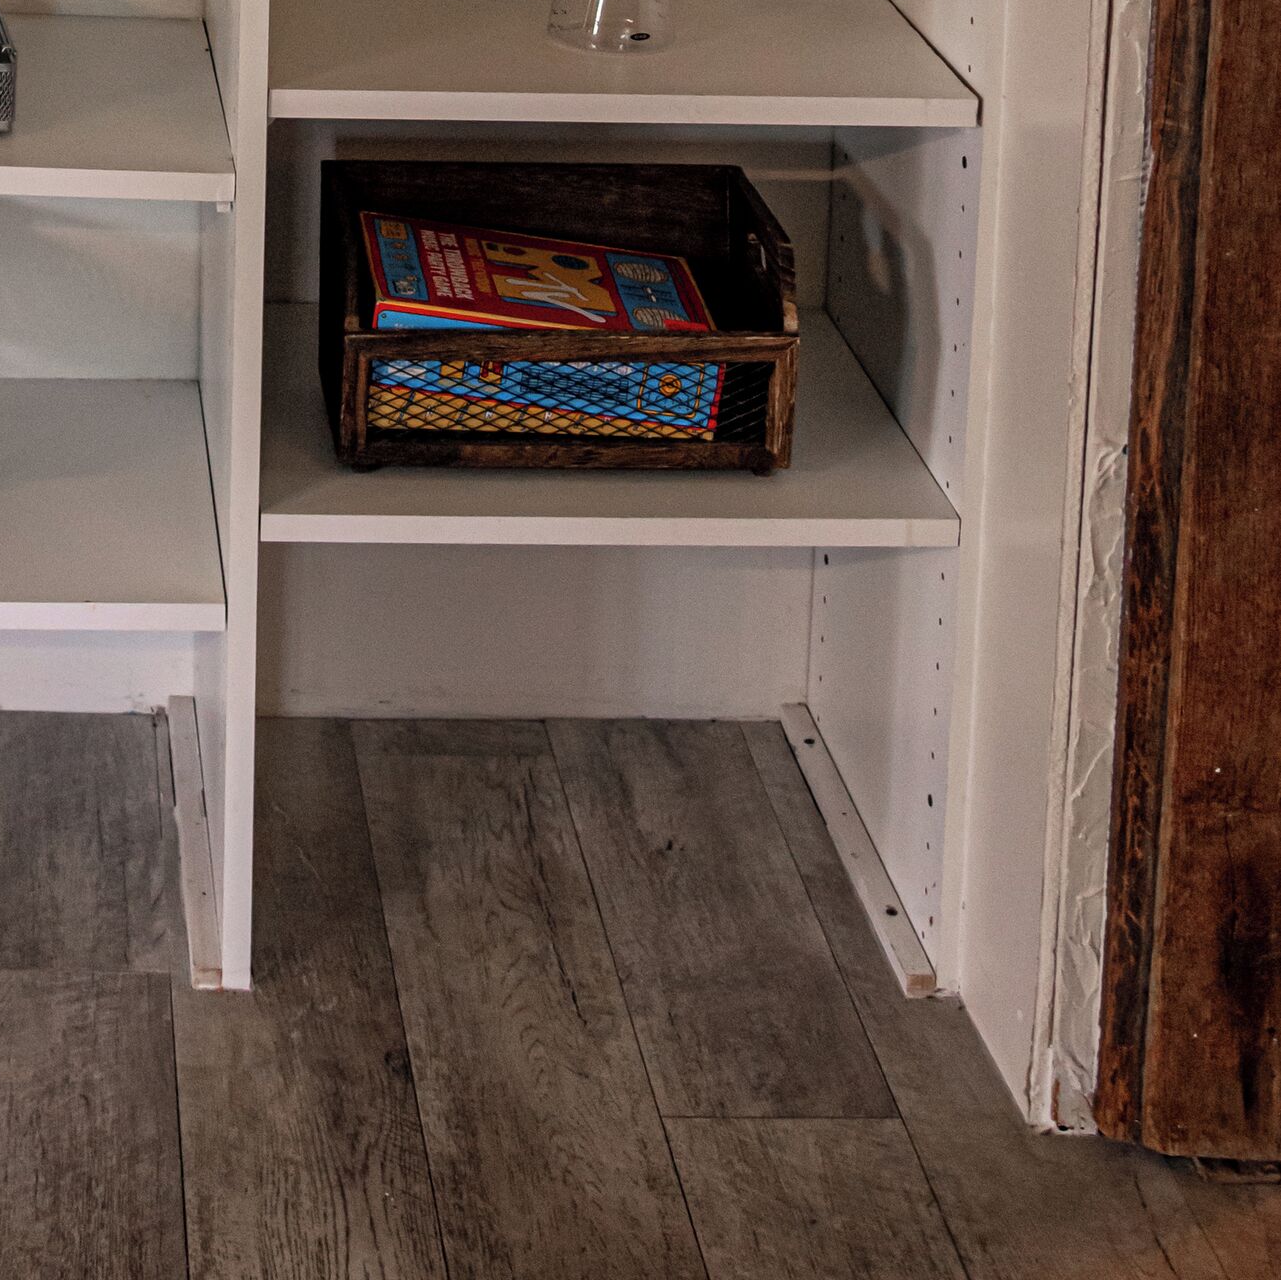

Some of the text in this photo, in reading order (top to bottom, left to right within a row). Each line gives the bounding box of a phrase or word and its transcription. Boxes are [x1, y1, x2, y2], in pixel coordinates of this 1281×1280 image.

[420, 229, 454, 298] MUSIC PARTY GAME
[438, 232, 475, 301] THE THROWBACK
